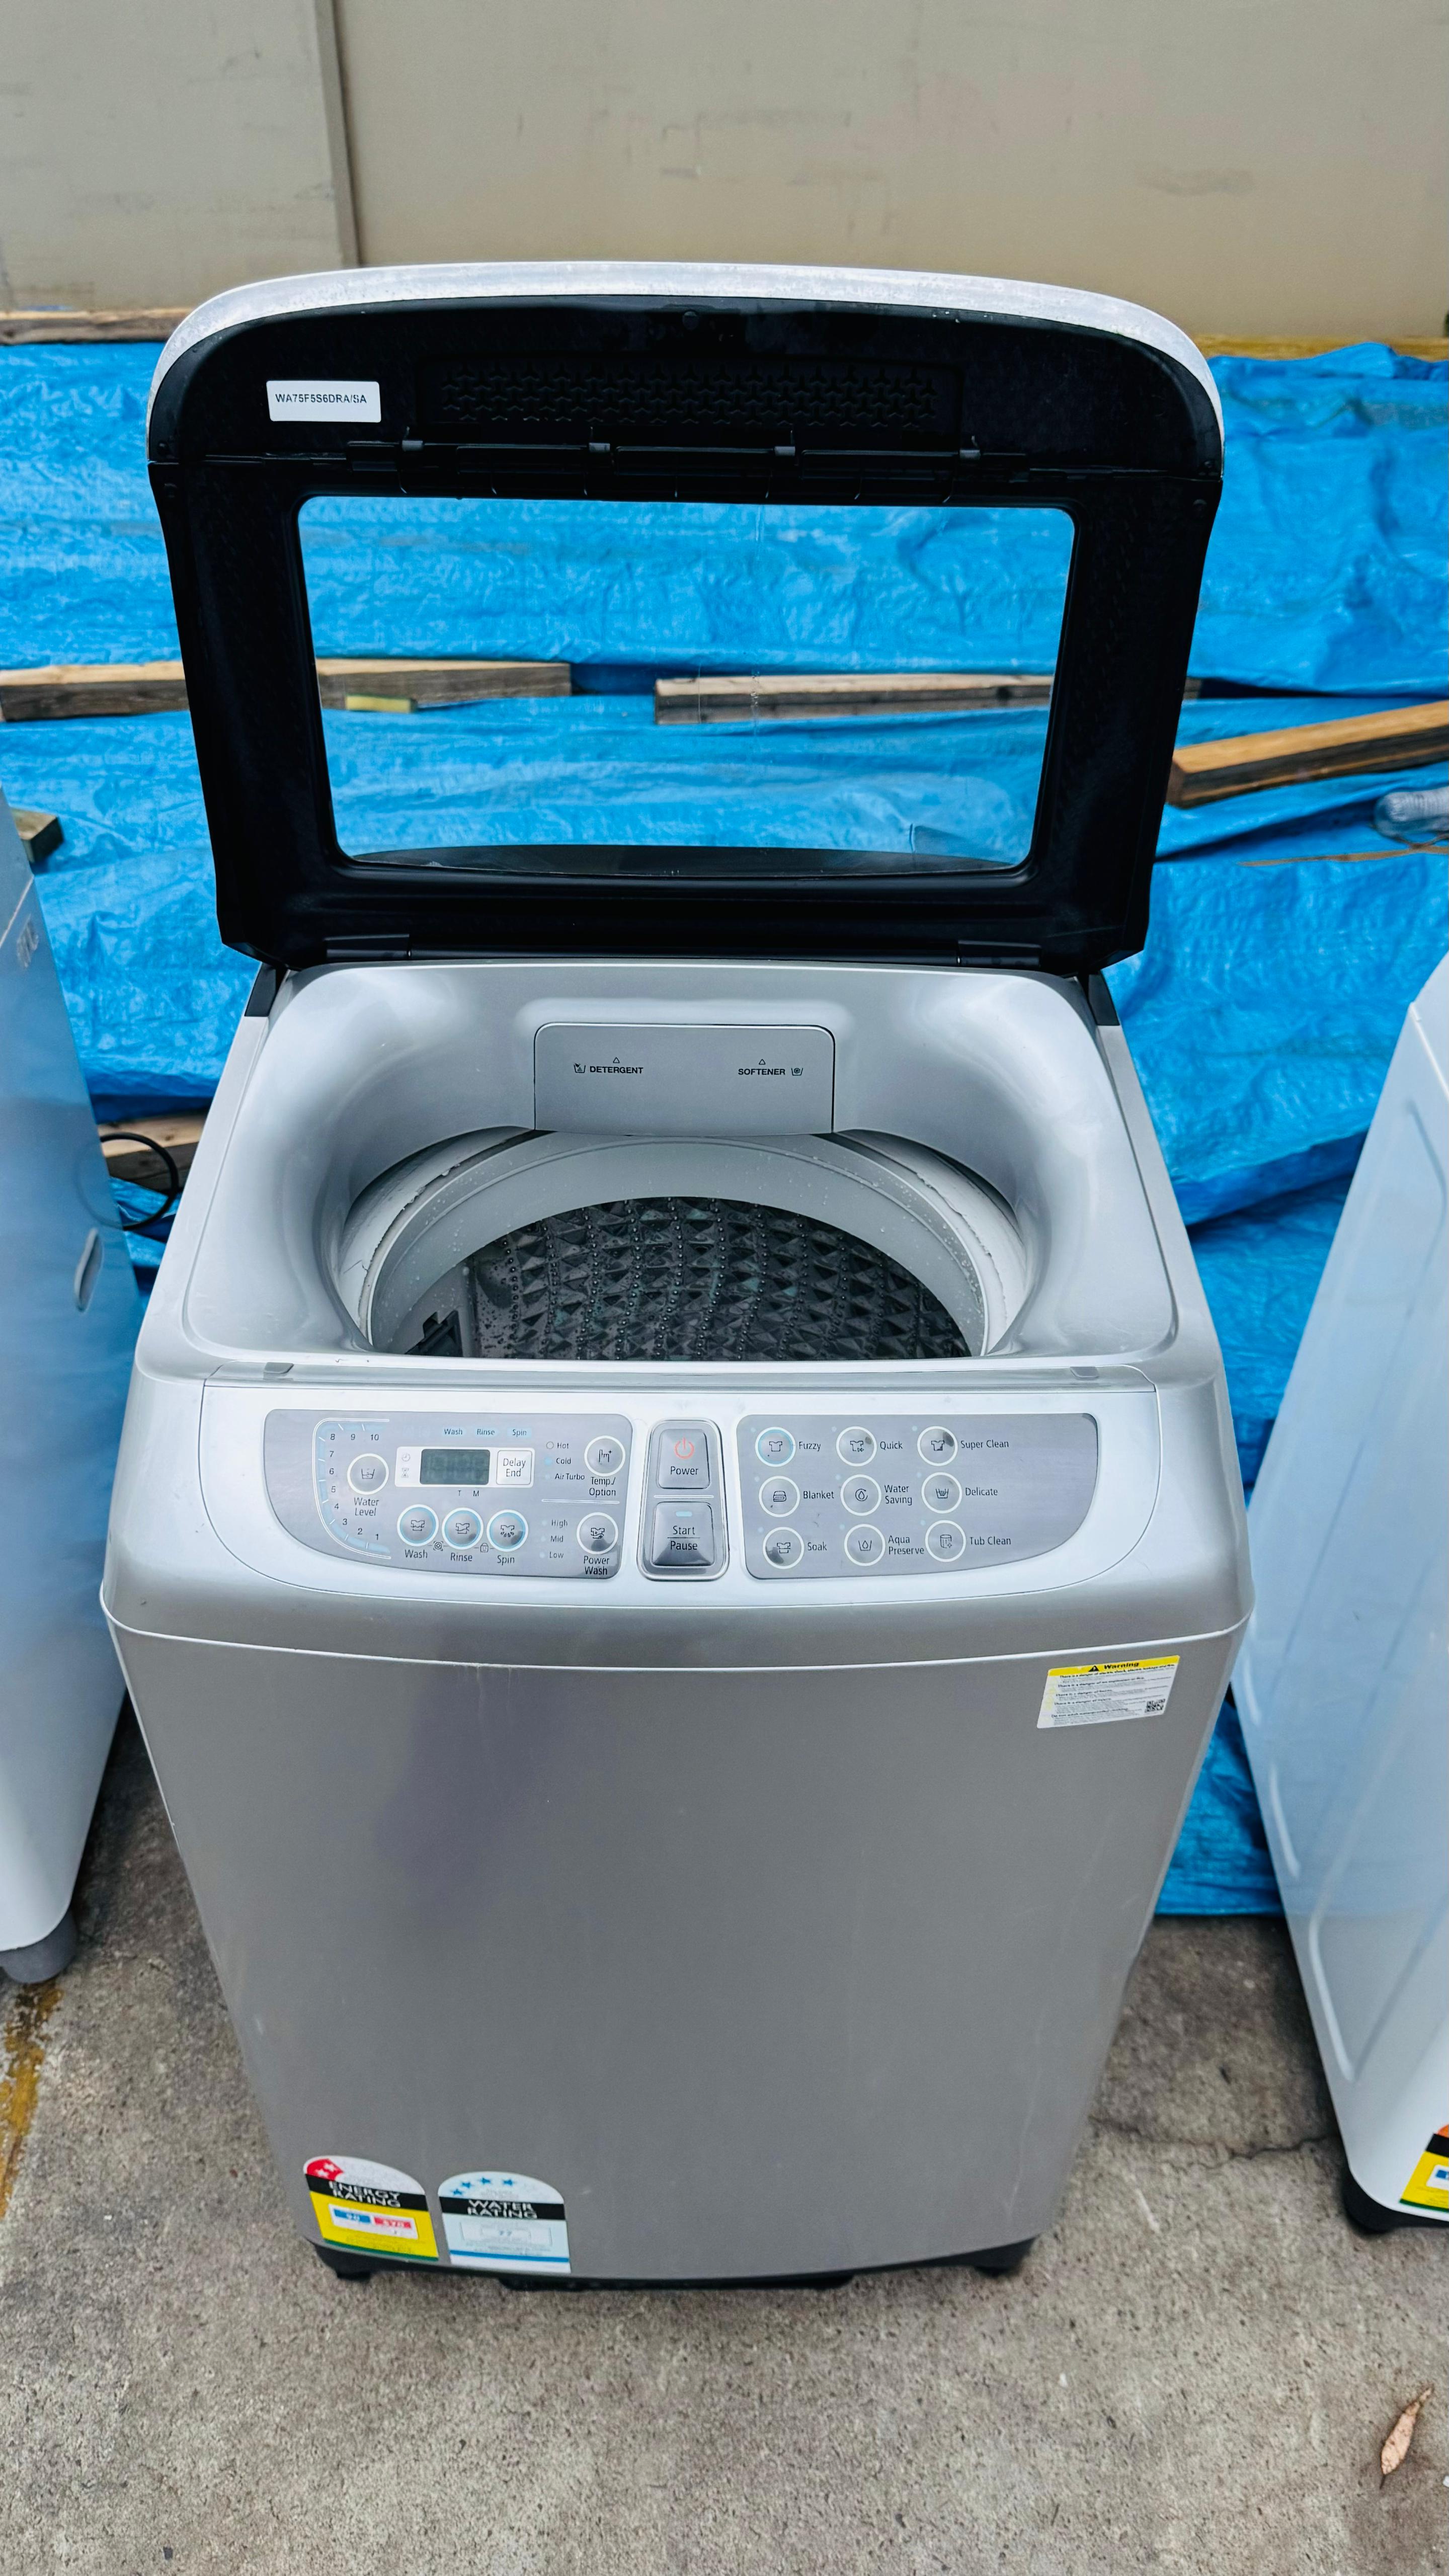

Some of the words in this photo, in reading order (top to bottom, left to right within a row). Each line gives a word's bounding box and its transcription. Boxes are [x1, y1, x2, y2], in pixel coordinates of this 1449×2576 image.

[275, 394, 367, 404] WA75F5S6DRA/SA
[590, 1065, 644, 1075] DETERGENT
[738, 1068, 786, 1076] SOFTENER
[512, 1429, 527, 1437] Spin
[799, 1441, 822, 1452] Fuzzy
[880, 1440, 904, 1451] Quick
[960, 1439, 984, 1451] Super
[986, 1439, 1009, 1448] Clean
[503, 1458, 526, 1469] Delay
[506, 1468, 521, 1477] End
[670, 1466, 699, 1476] Power
[566, 1473, 585, 1481] Turbo
[589, 1487, 616, 1498] Option
[884, 1484, 910, 1493] Water
[965, 1487, 998, 1496] Delicate
[803, 1490, 835, 1500] Blanket
[885, 1495, 913, 1505] Saving
[354, 1497, 379, 1506] Water
[355, 1507, 377, 1516] Level
[551, 1519, 568, 1528] High
[673, 1525, 696, 1536] Start
[888, 1535, 910, 1546] Aqua
[969, 1537, 985, 1546] Tub
[987, 1536, 1011, 1546] Clean
[670, 1541, 698, 1551] Pause
[807, 1542, 828, 1552] Soak
[889, 1546, 925, 1555] Preserve
[405, 1549, 428, 1559] Wash
[450, 1552, 473, 1562] Rinse
[497, 1555, 515, 1566] Spin
[583, 1555, 610, 1565] Power
[584, 1565, 608, 1576] Wash
[1104, 1662, 1140, 1670] Warning
[329, 2181, 400, 2200] ENERGY
[332, 2190, 401, 2208] RATING
[468, 2199, 534, 2211] WATER
[467, 2207, 538, 2219] RATING
